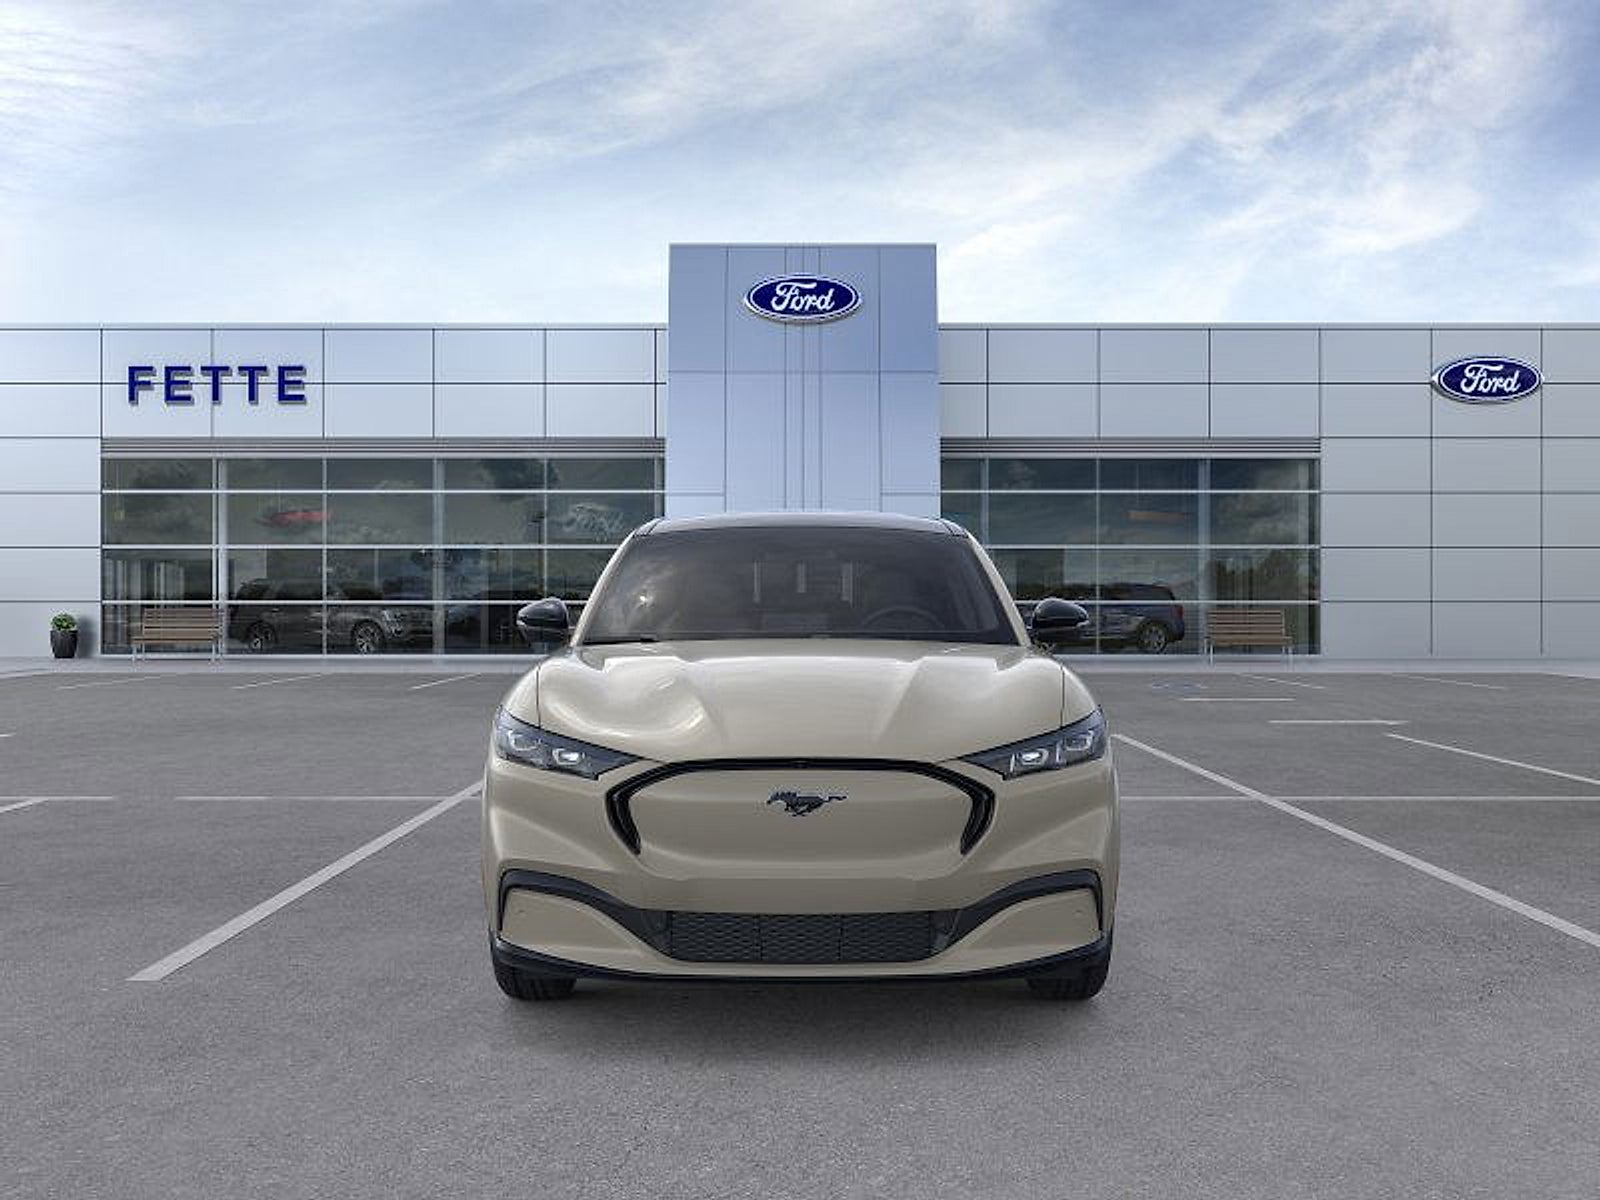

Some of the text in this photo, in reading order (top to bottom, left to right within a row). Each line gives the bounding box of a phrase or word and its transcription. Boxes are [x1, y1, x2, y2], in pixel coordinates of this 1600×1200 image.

[771, 281, 835, 312] Ford
[128, 365, 306, 404] FETTE
[1460, 363, 1521, 393] Ford
